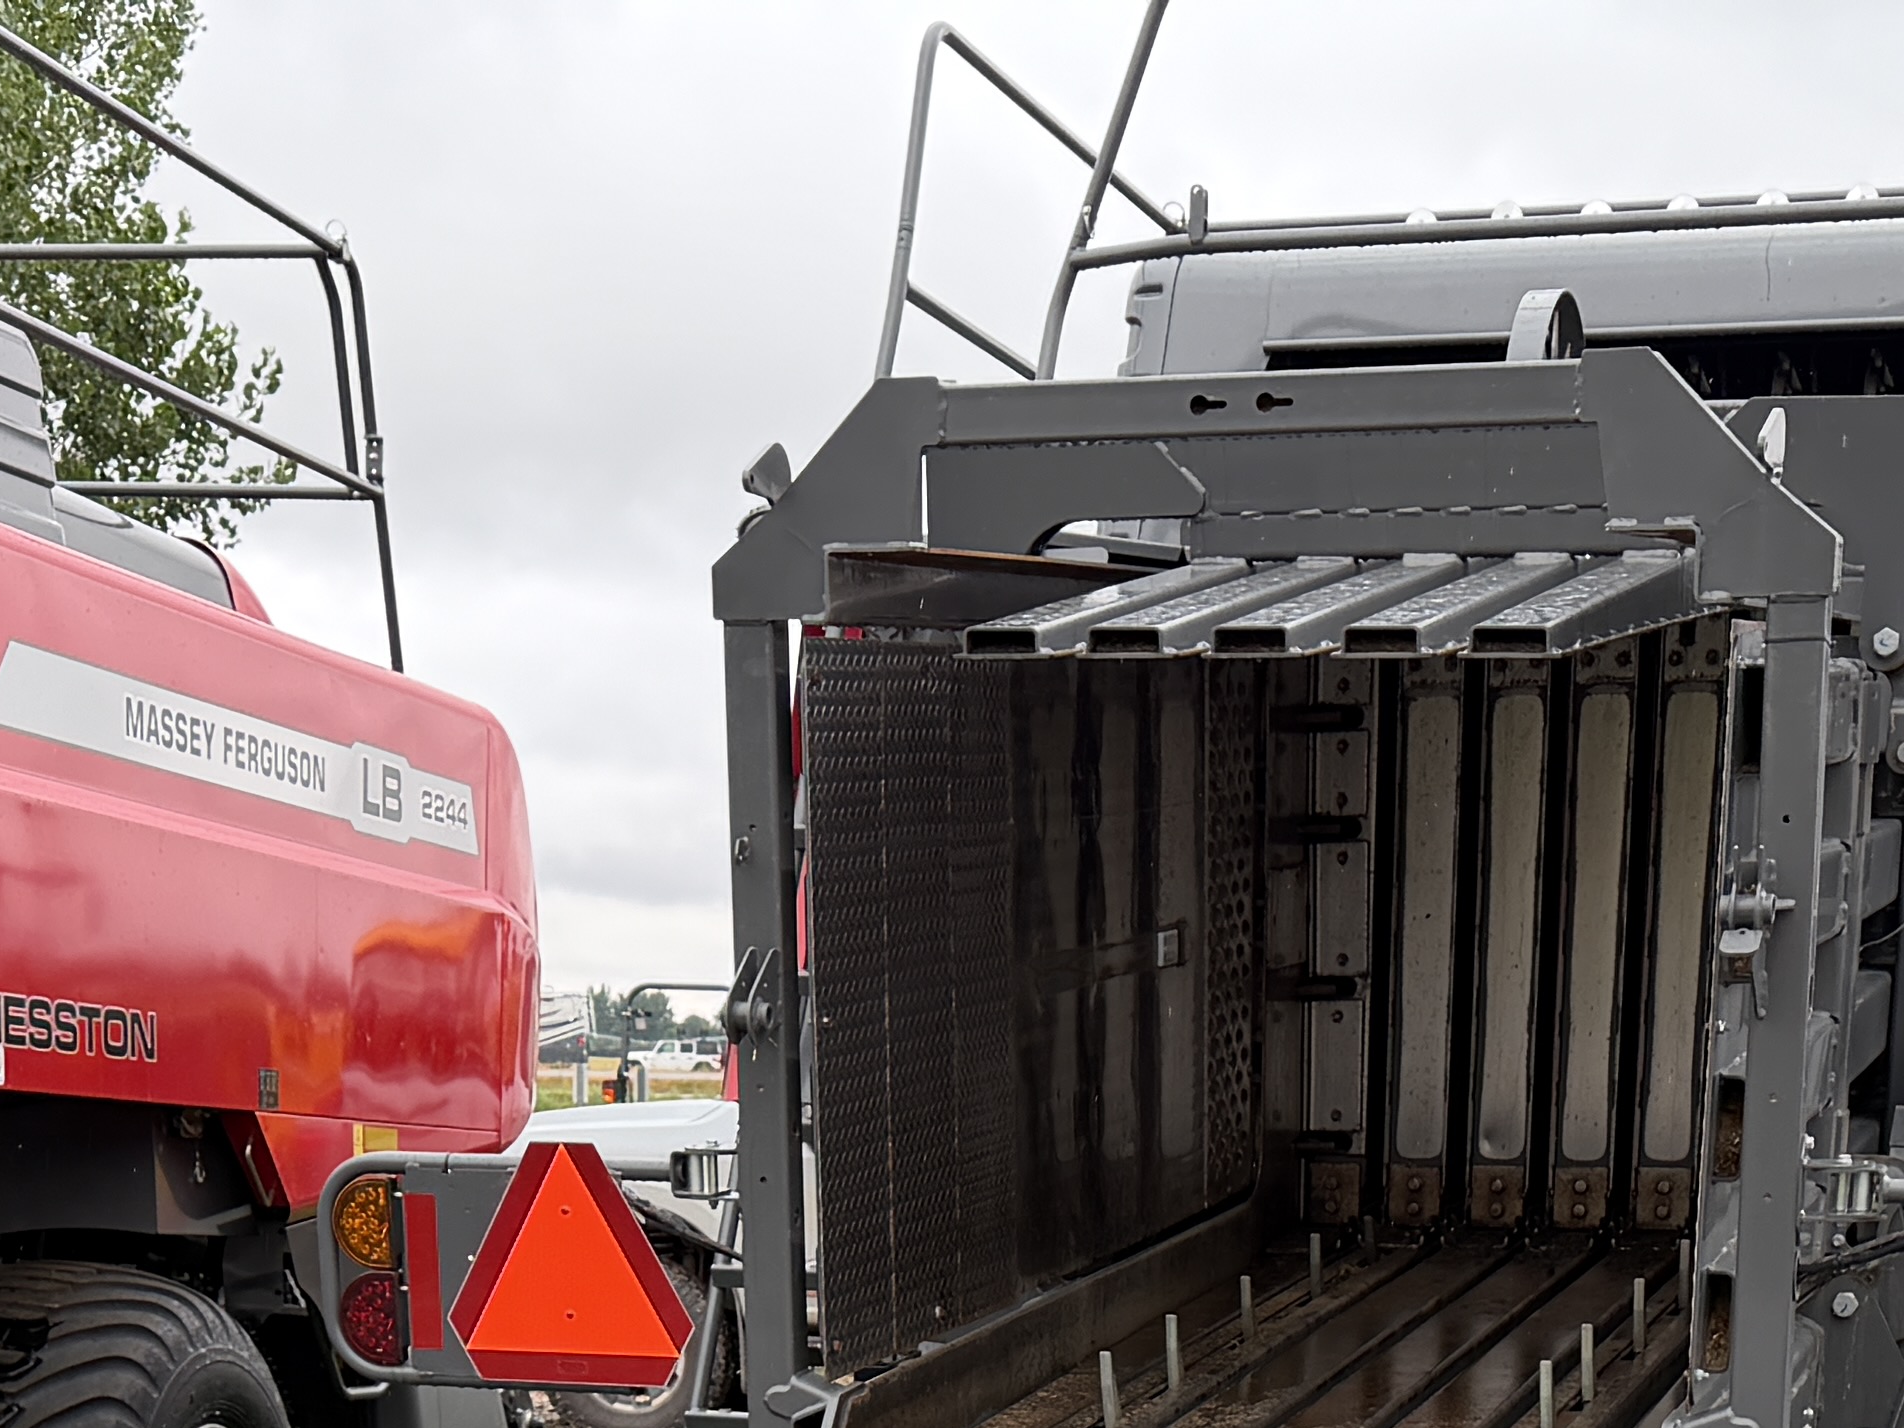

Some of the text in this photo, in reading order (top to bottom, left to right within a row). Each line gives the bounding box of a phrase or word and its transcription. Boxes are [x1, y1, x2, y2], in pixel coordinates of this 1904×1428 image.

[125, 696, 326, 793] MASSEY FERGUSON
[362, 756, 469, 830] LB 2244
